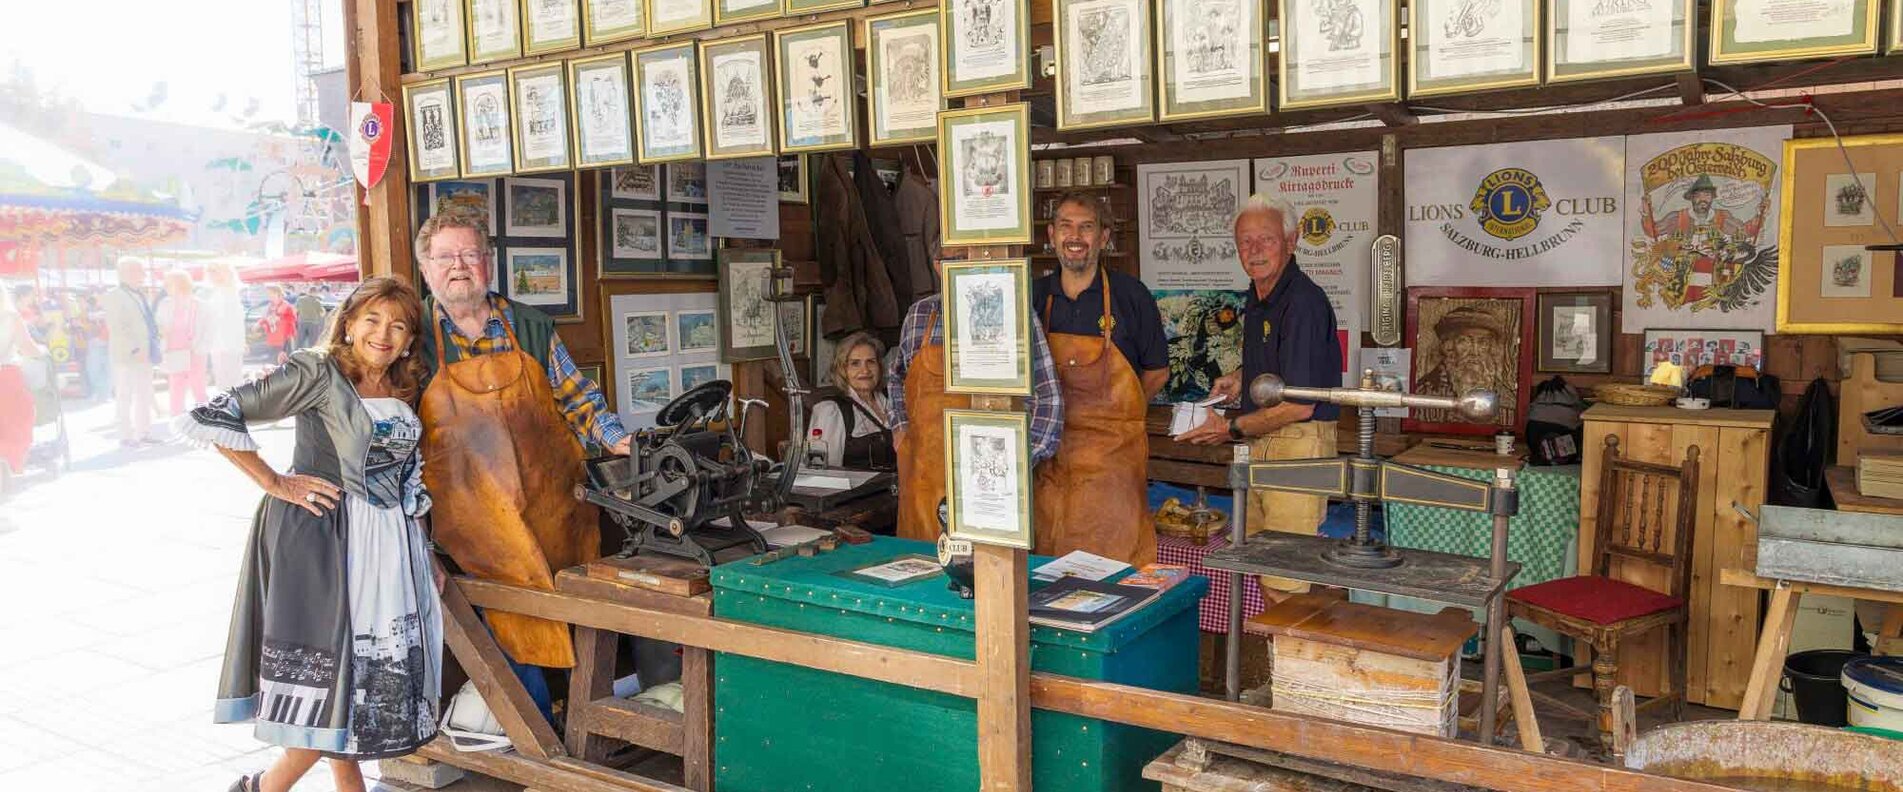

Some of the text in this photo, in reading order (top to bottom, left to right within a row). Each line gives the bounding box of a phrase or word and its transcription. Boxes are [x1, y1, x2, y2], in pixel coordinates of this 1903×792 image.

[1648, 153, 1678, 175] 200
[1711, 146, 1767, 177] Salzburg
[1486, 171, 1534, 189] LIONS
[1409, 196, 1617, 222] LIONS CLUB
[1500, 190, 1522, 216] L
[1312, 218, 1322, 234] L
[1338, 221, 1370, 232] CLUB
[1440, 218, 1583, 260] SALZBURG-HELLBRUNN
